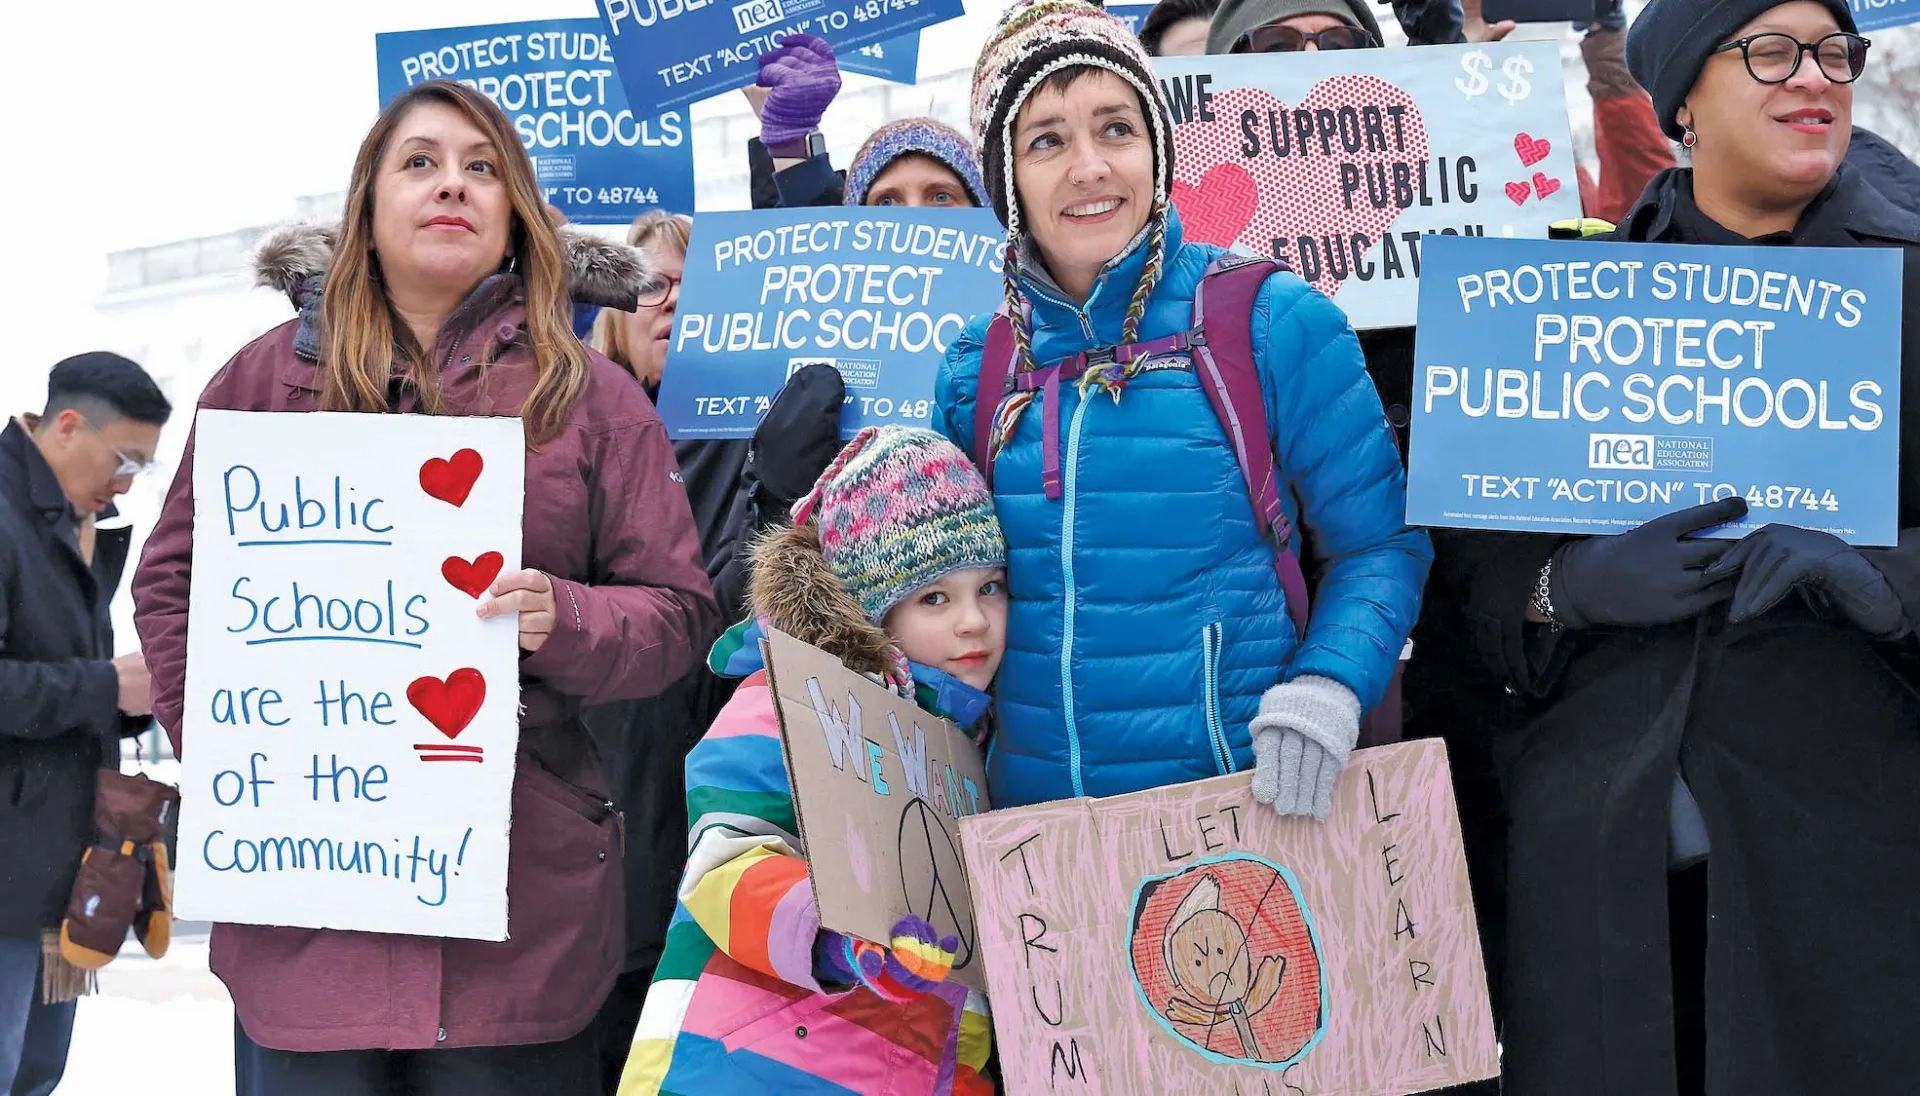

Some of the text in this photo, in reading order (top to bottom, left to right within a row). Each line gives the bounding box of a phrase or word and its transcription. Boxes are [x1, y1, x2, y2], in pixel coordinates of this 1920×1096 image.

[401, 34, 522, 86] PROTECT
[657, 54, 713, 88] TEXT
[815, 11, 849, 34] TO
[1159, 73, 1216, 126] WE
[515, 109, 683, 150] SCHOOLS
[1241, 105, 1406, 158] SUPPORT
[563, 187, 592, 204] TO
[597, 187, 659, 204] 48744
[1341, 155, 1478, 210] PUBLIC
[715, 220, 1010, 273] PROTECT STUDENTS
[1273, 224, 1484, 282] EDUCAT
[760, 264, 943, 306] PROTECT
[1457, 261, 1867, 328] PROTECT STUDENTS
[677, 309, 975, 354] PUBLIC SCHOO
[1534, 313, 1775, 370] PROTECT
[840, 370, 877, 378] DUCATION
[1425, 365, 1884, 432] PUBLIC SCHOOLS
[695, 396, 750, 416] TEXT
[860, 397, 893, 417] TO
[1593, 438, 1649, 466] nea
[1656, 449, 1710, 459] EDUCATION
[1656, 459, 1709, 468] ASSOCIATION
[1657, 440, 1710, 450] NATIONAL
[224, 465, 394, 535] Public
[1462, 473, 1839, 512] TEXT "ACTION" TO 48744
[227, 577, 430, 636] Schools
[211, 680, 396, 726] are the
[212, 753, 388, 807] of the
[888, 710, 979, 820] WANT
[1159, 806, 1241, 862] LET
